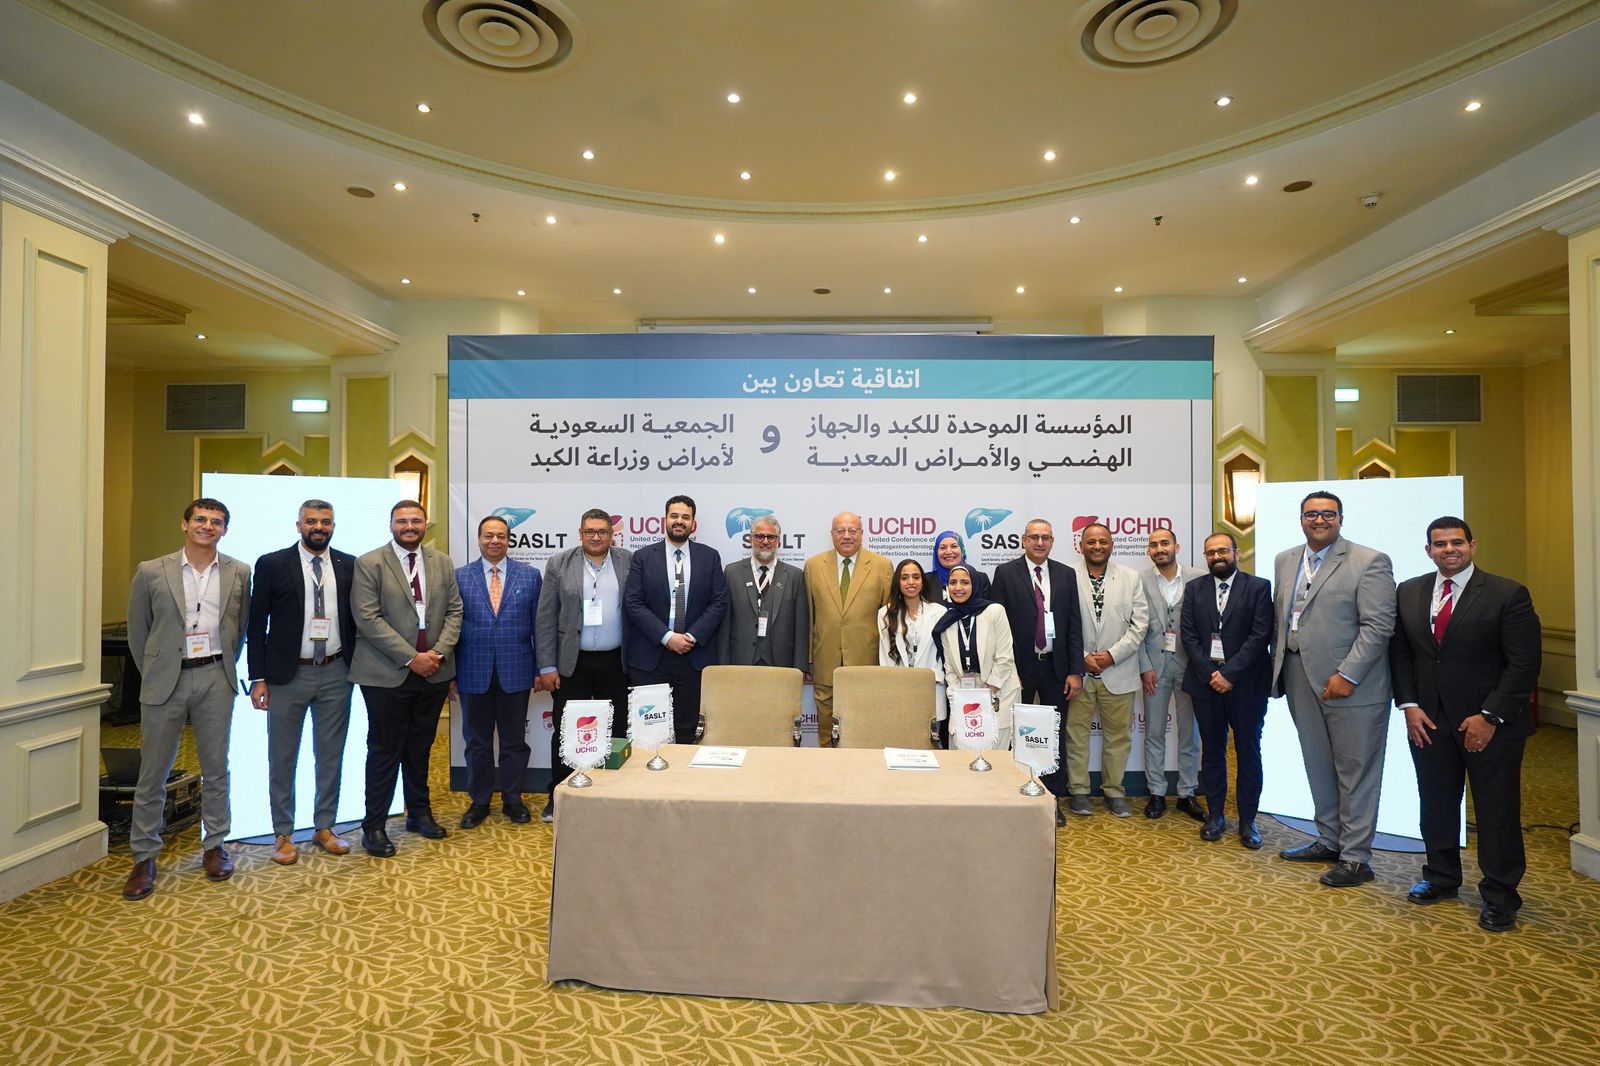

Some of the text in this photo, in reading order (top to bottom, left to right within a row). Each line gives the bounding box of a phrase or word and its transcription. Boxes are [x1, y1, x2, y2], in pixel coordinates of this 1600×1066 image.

[742, 366, 920, 395] اتفاقية تعاون بين
[529, 412, 734, 440] الجمعية السعودية
[805, 413, 1132, 440] المؤسسة الموحدة للكبد والجهاز
[759, 424, 781, 454] و
[530, 442, 734, 473] لأمراض وزراعة الكبد
[806, 443, 1132, 478] الهضمي والأمراض المعدية
[868, 516, 937, 535] UCHID
[507, 532, 568, 549] SASLT
[742, 533, 806, 549] SLT
[981, 533, 1026, 550] SAS
[644, 711, 667, 721] SASLT
[1025, 735, 1049, 744] SASLT
[575, 746, 598, 754] UCHID
